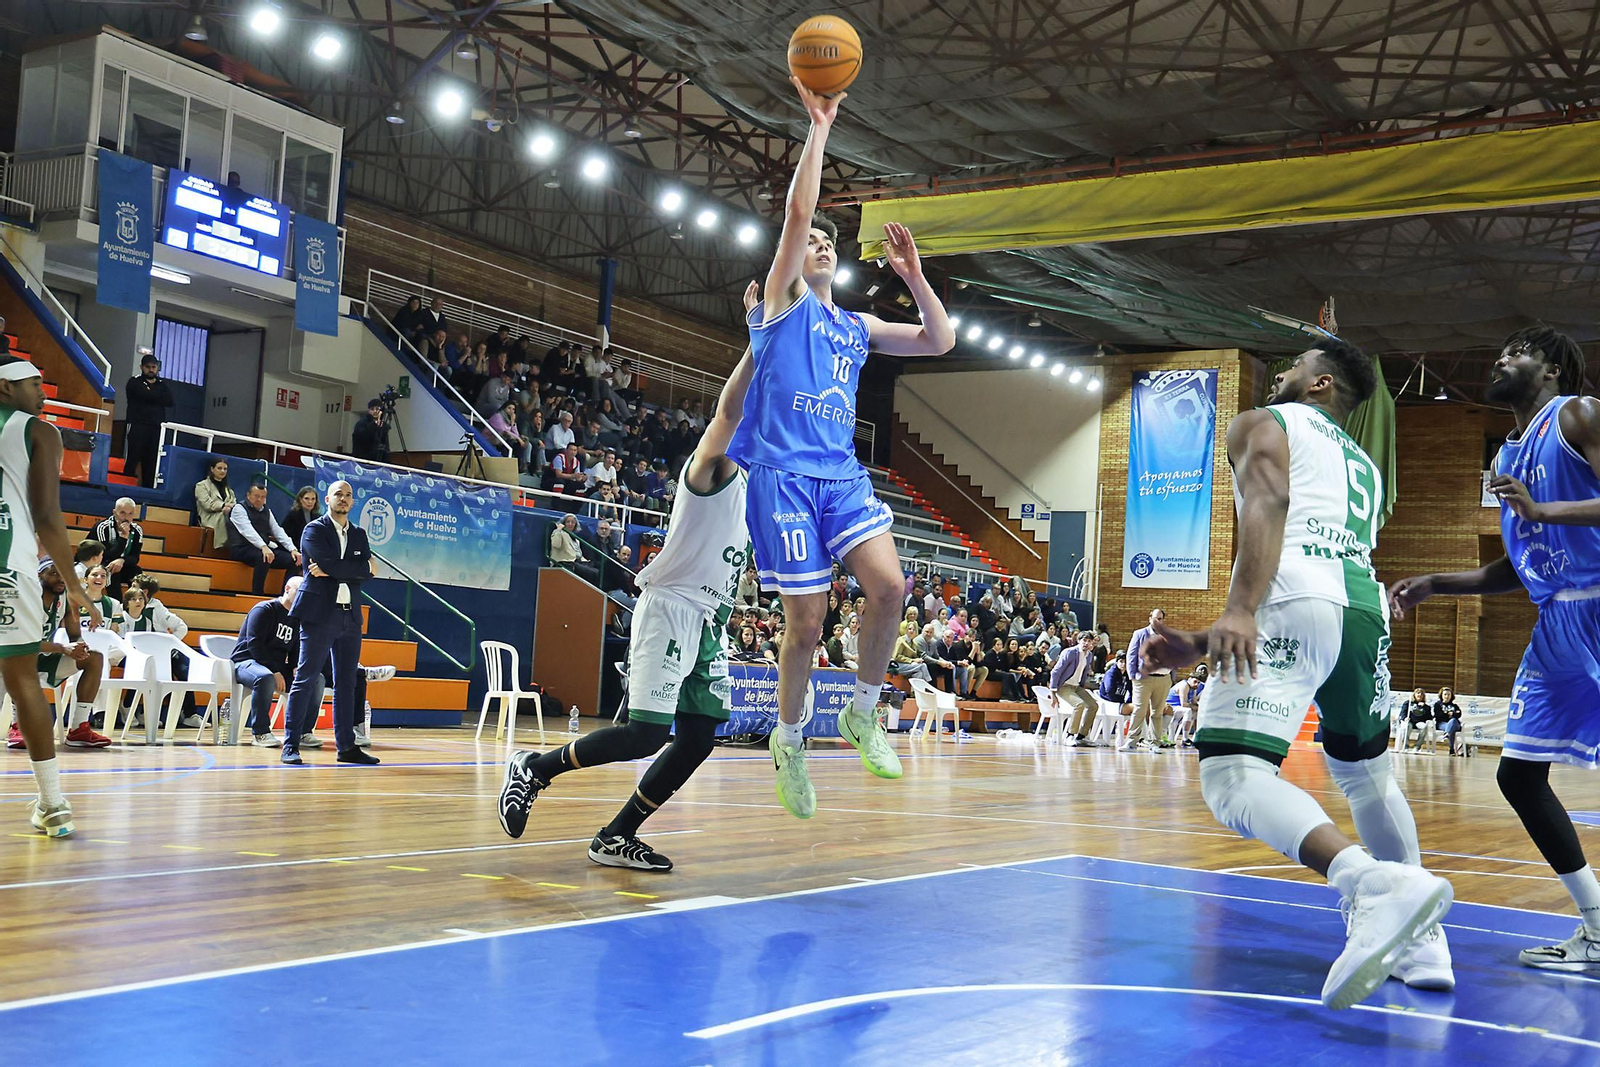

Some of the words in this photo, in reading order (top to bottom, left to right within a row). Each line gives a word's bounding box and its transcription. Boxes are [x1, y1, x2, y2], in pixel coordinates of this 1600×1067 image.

[103, 241, 150, 259] Ayuntamiento
[109, 252, 118, 260] de
[120, 254, 144, 266] Huelva
[298, 273, 335, 287] Ayuntamiento
[303, 282, 311, 290] de
[311, 283, 331, 294] Huelva
[831, 353, 853, 384] 10
[213, 396, 227, 408] 116
[325, 402, 341, 413] 117
[792, 395, 857, 430] EMERITA
[1139, 468, 1203, 489] Apoyamos
[1139, 485, 1154, 497] tu
[1156, 481, 1203, 501] esfuerzo
[1347, 459, 1371, 522] 5
[397, 506, 458, 524] Ayuntamiento
[413, 519, 425, 530] de
[426, 521, 457, 534] Huelva
[780, 529, 808, 562] 10
[744, 690, 755, 702] de
[829, 693, 840, 705] de
[1235, 696, 1290, 718] efficold
